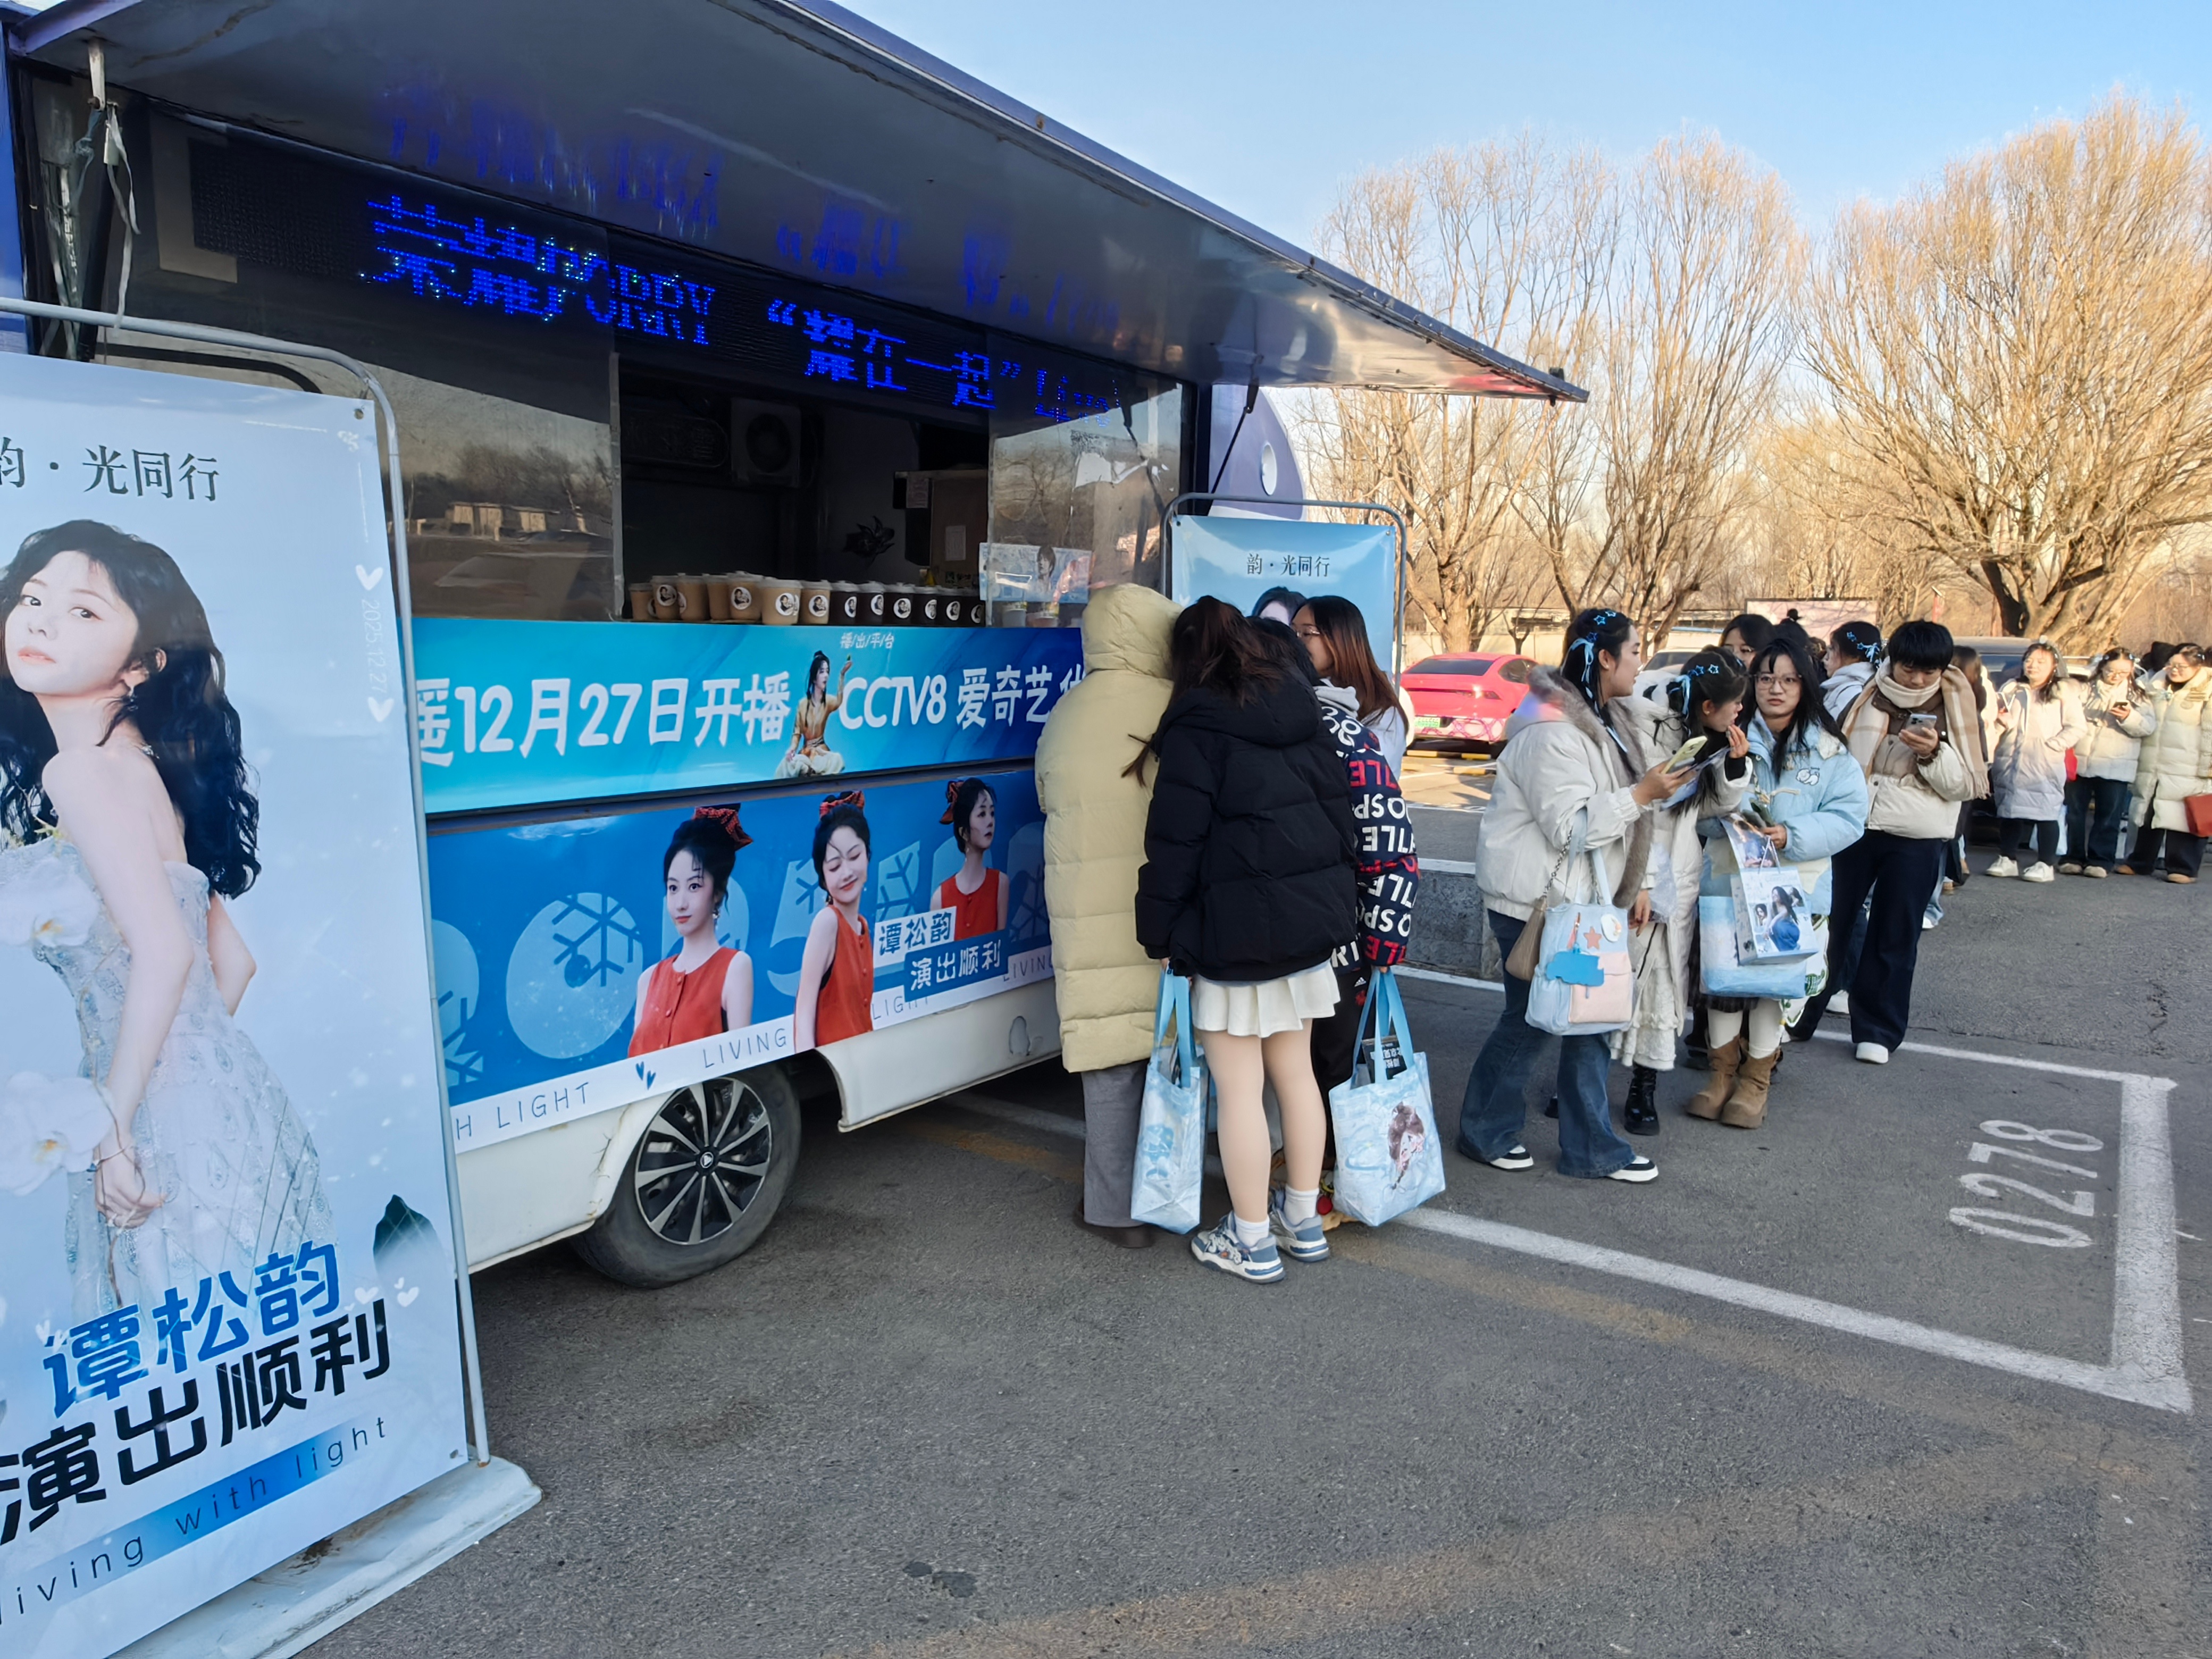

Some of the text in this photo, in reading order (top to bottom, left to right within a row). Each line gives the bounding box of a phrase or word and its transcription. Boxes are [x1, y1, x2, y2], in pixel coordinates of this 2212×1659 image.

[1246, 553, 1330, 577] 韵·光同行
[838, 674, 946, 730] CCTV8
[879, 911, 952, 956] 谭松韵
[910, 939, 1002, 992] 演出顺利
[702, 1027, 788, 1069] LIVING
[497, 1082, 589, 1129] LIGHT
[1949, 1120, 2104, 1248] 0278
[43, 1239, 340, 1418] 谭松韵
[0, 1297, 390, 1546] 演出顺利
[0, 1417, 387, 1626] iving with light
